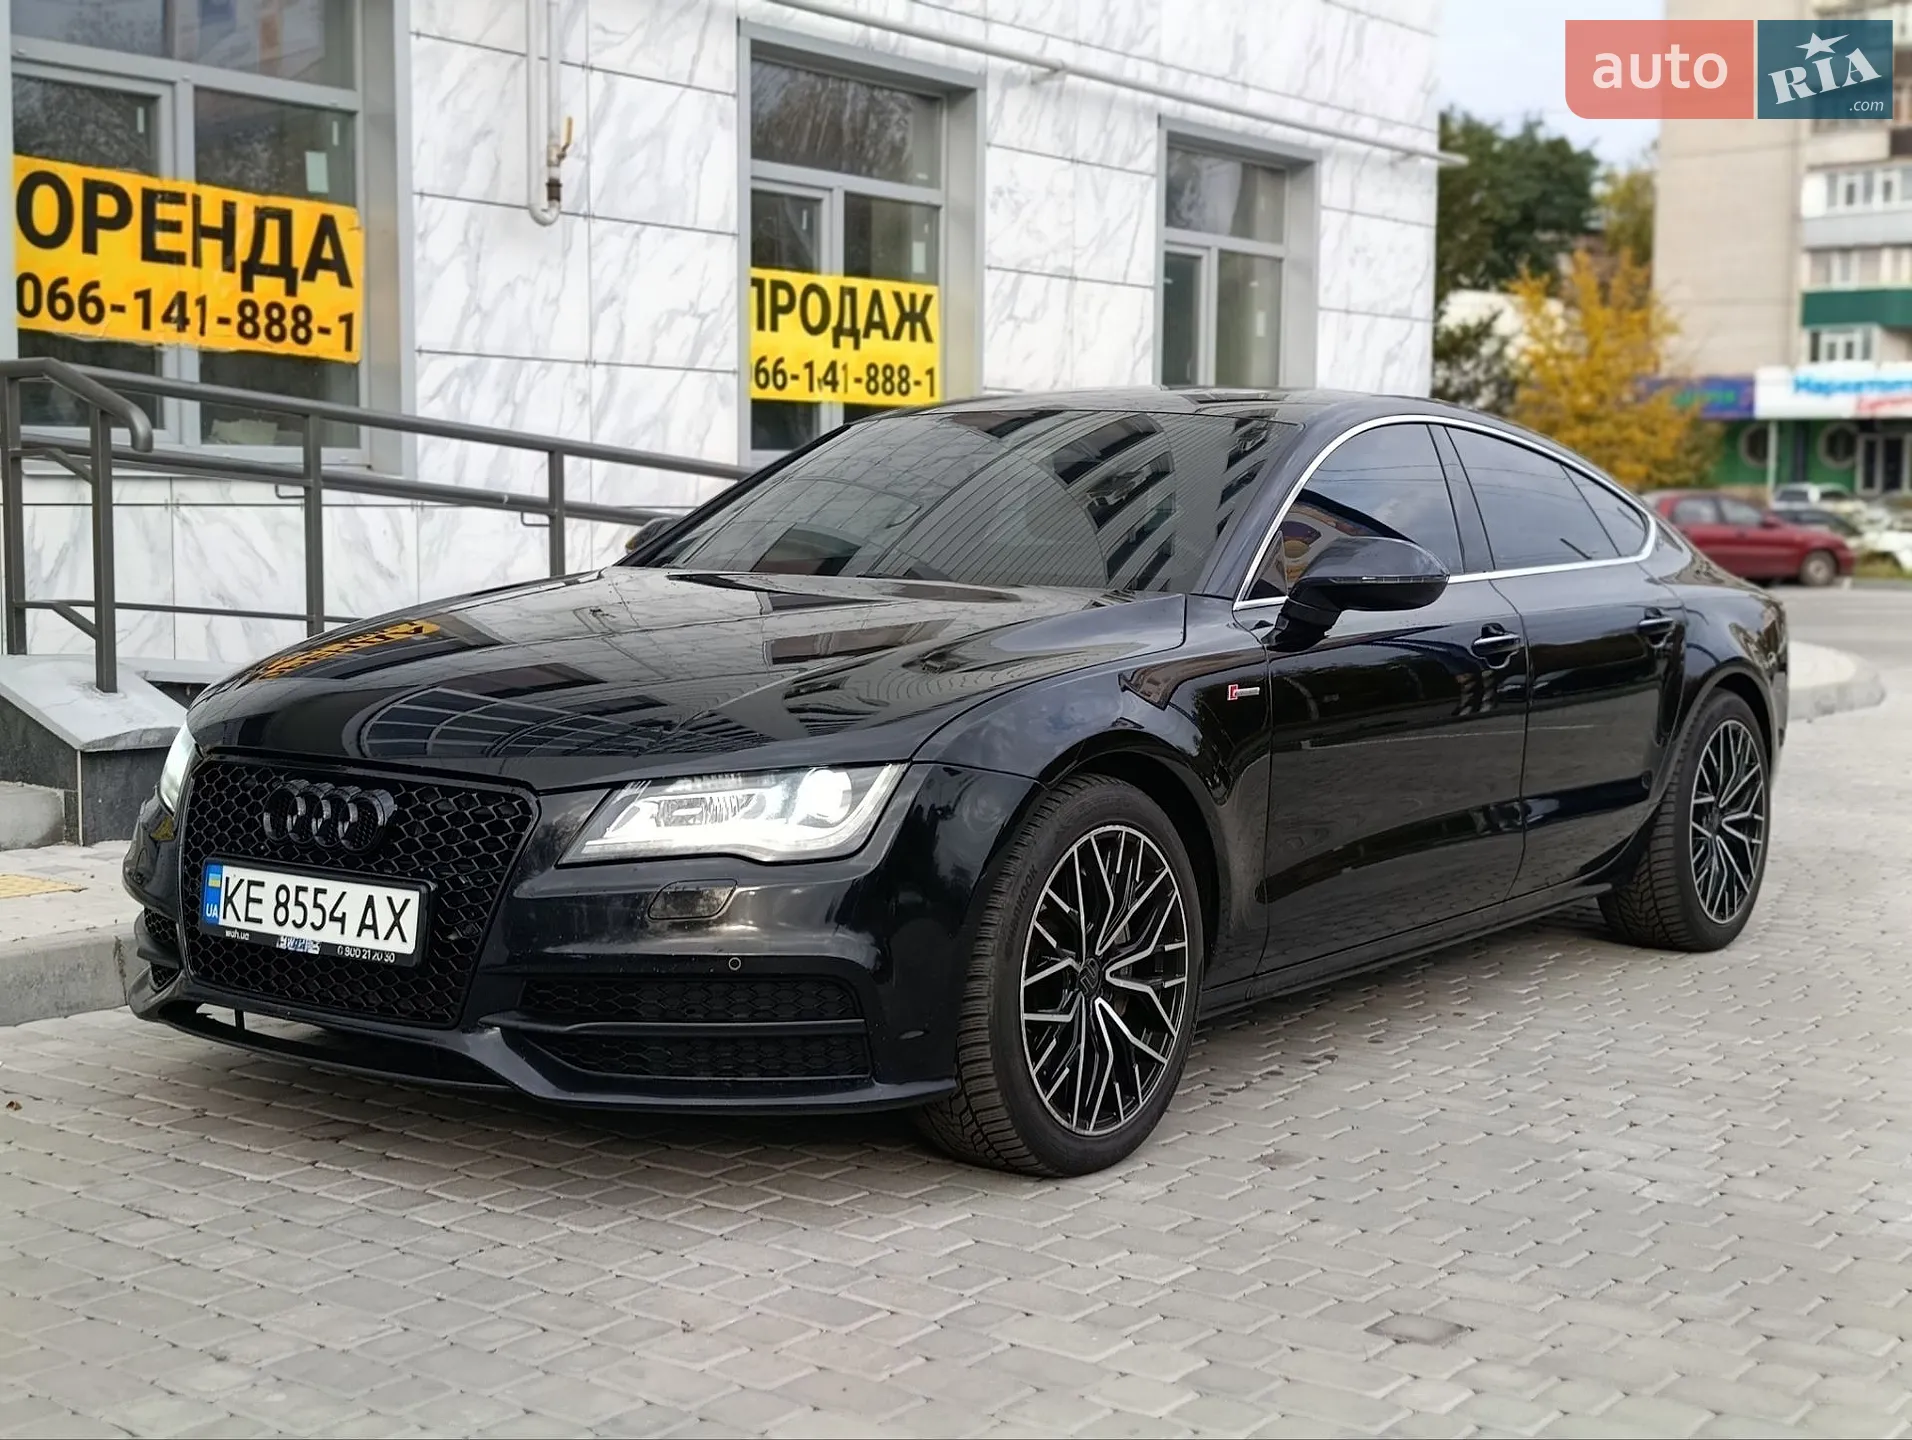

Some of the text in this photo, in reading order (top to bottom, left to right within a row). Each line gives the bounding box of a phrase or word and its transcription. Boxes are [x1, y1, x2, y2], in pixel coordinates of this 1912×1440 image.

[16, 170, 354, 297] ОРЕНДА
[16, 272, 355, 352] 066-141-888-1
[751, 277, 934, 350] ПРОДАЖ
[750, 355, 935, 397] 66-141-888-1
[206, 903, 219, 919] UA
[222, 876, 412, 943] KE 8554 AX
